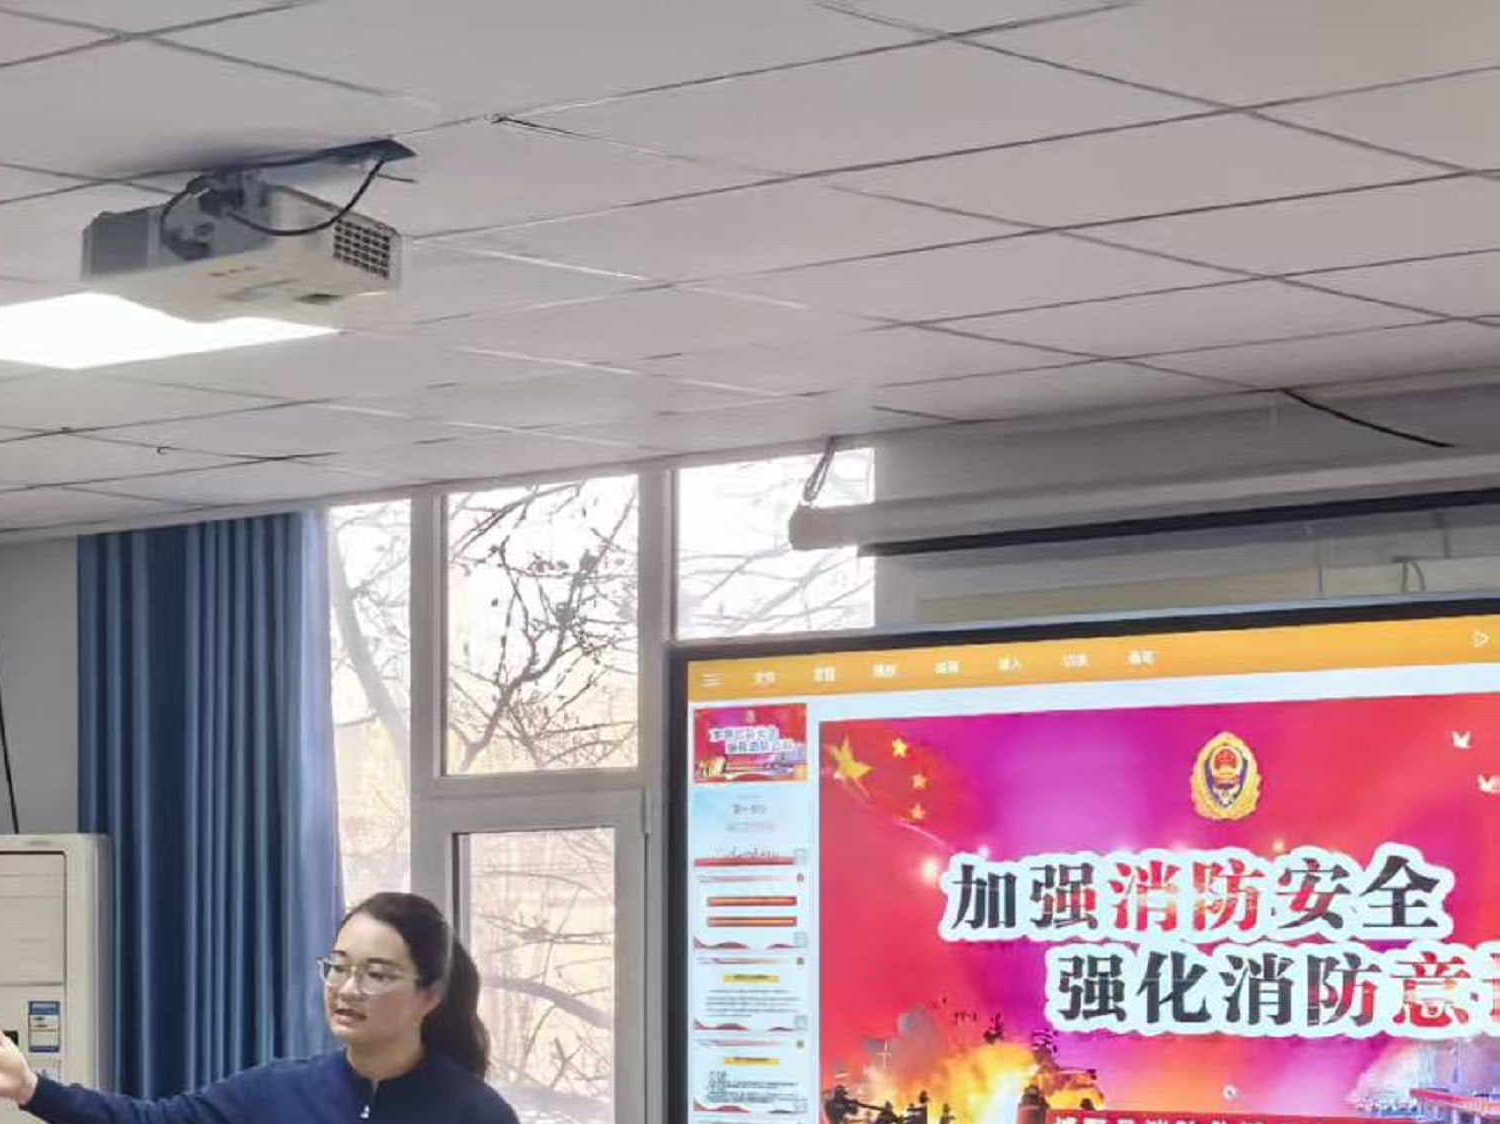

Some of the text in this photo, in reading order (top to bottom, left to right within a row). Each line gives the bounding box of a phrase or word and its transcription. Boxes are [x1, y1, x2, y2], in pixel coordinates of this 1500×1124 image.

[950, 855, 1442, 932] 加强消防安全
[1057, 950, 1500, 1028] 强化消防意
